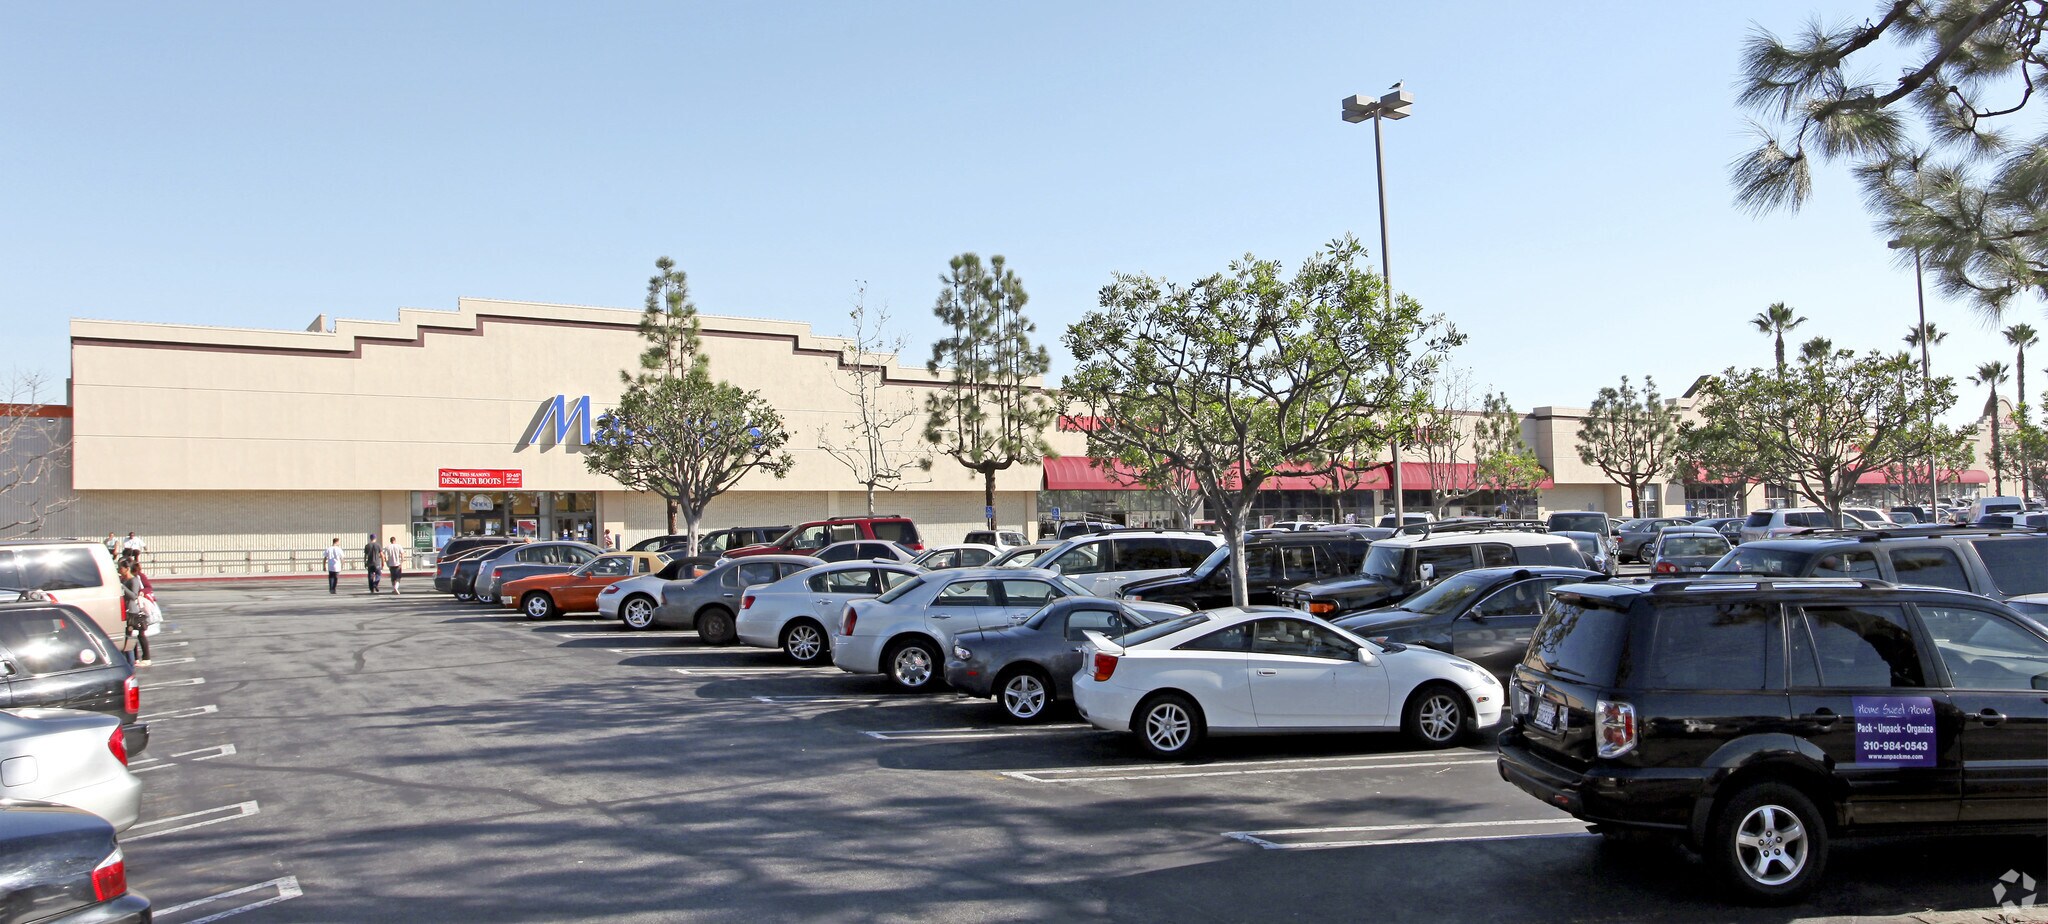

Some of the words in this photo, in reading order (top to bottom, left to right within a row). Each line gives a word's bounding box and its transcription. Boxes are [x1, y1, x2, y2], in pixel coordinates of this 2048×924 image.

[1857, 704, 1879, 714] Home
[1883, 703, 1905, 715] Sweet
[1908, 704, 1931, 715] Home
[1857, 723, 1873, 733] Pack
[1878, 723, 1902, 734] Unpack
[1906, 723, 1934, 735] Organize
[1863, 741, 1928, 750] 310-984-0543
